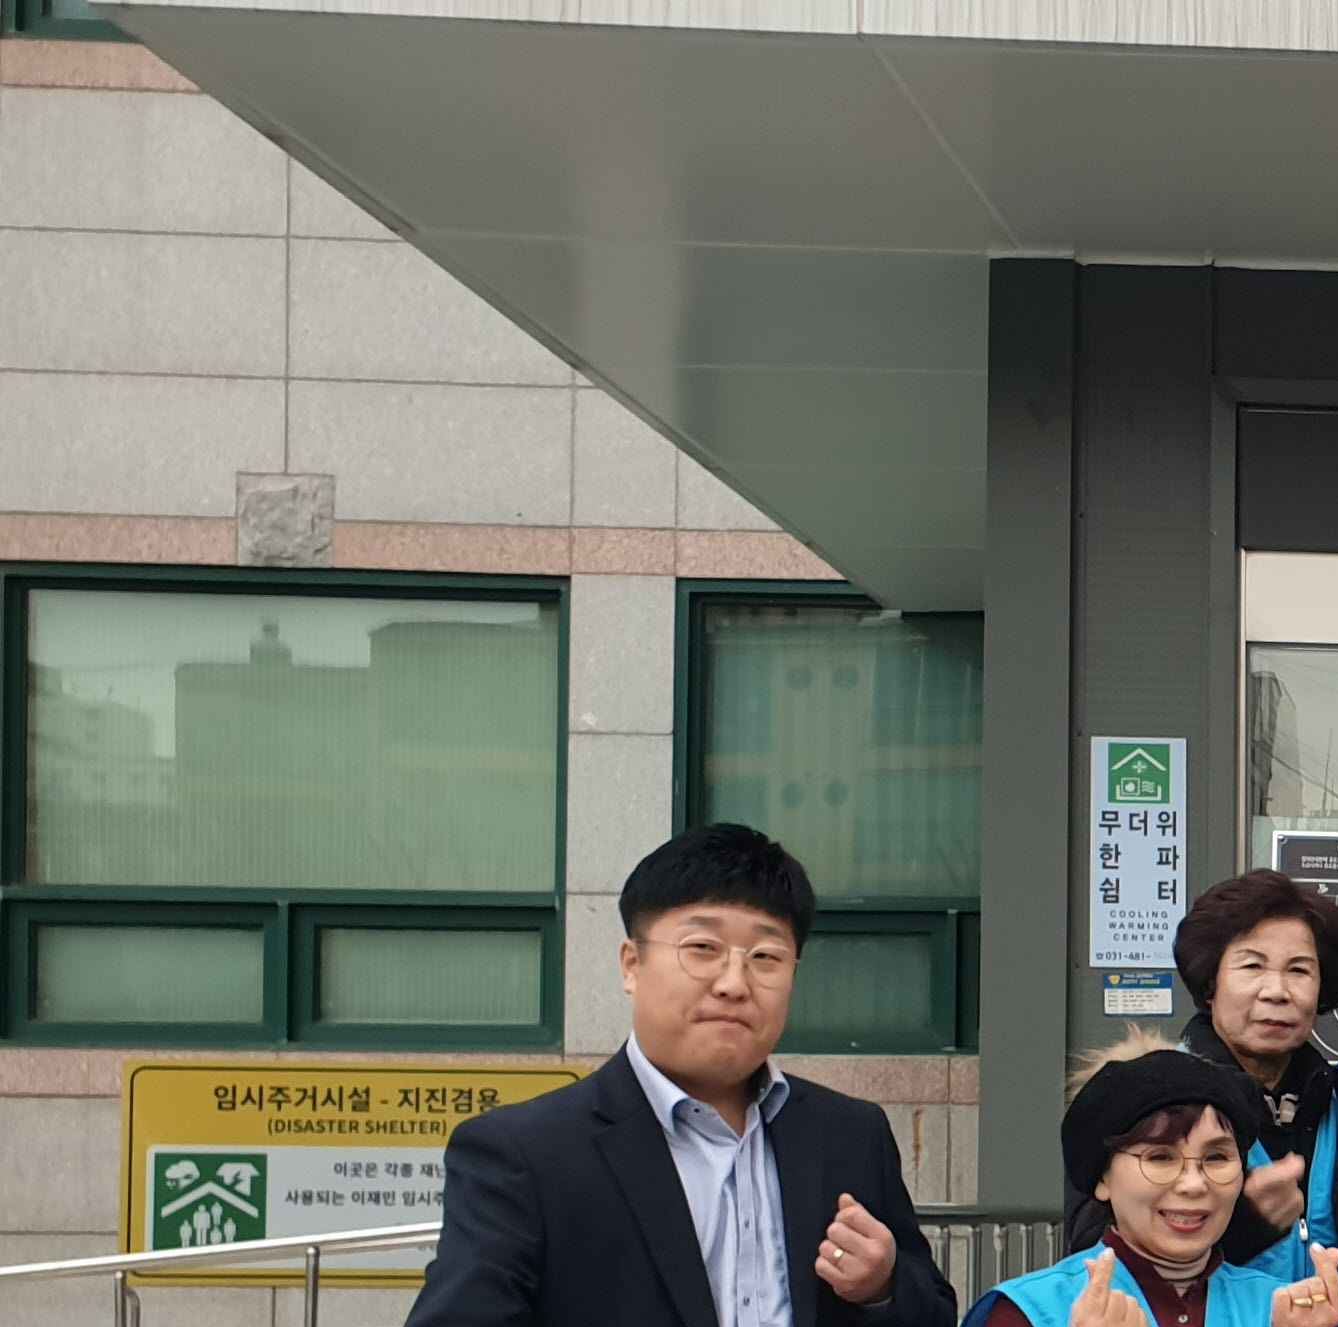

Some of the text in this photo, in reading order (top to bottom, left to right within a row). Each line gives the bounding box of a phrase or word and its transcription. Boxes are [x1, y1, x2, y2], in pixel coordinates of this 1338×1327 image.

[1110, 910, 1168, 919] COOLING
[1109, 922, 1169, 930] WARMING
[1113, 933, 1165, 942] CENTER
[213, 1085, 371, 1113] 임시주거시설
[398, 1087, 500, 1114] 지진겸용
[267, 1118, 448, 1137] (DISASTER SHELTER)
[333, 1162, 378, 1178] 이곳은
[285, 1190, 346, 1206] 사용되는
